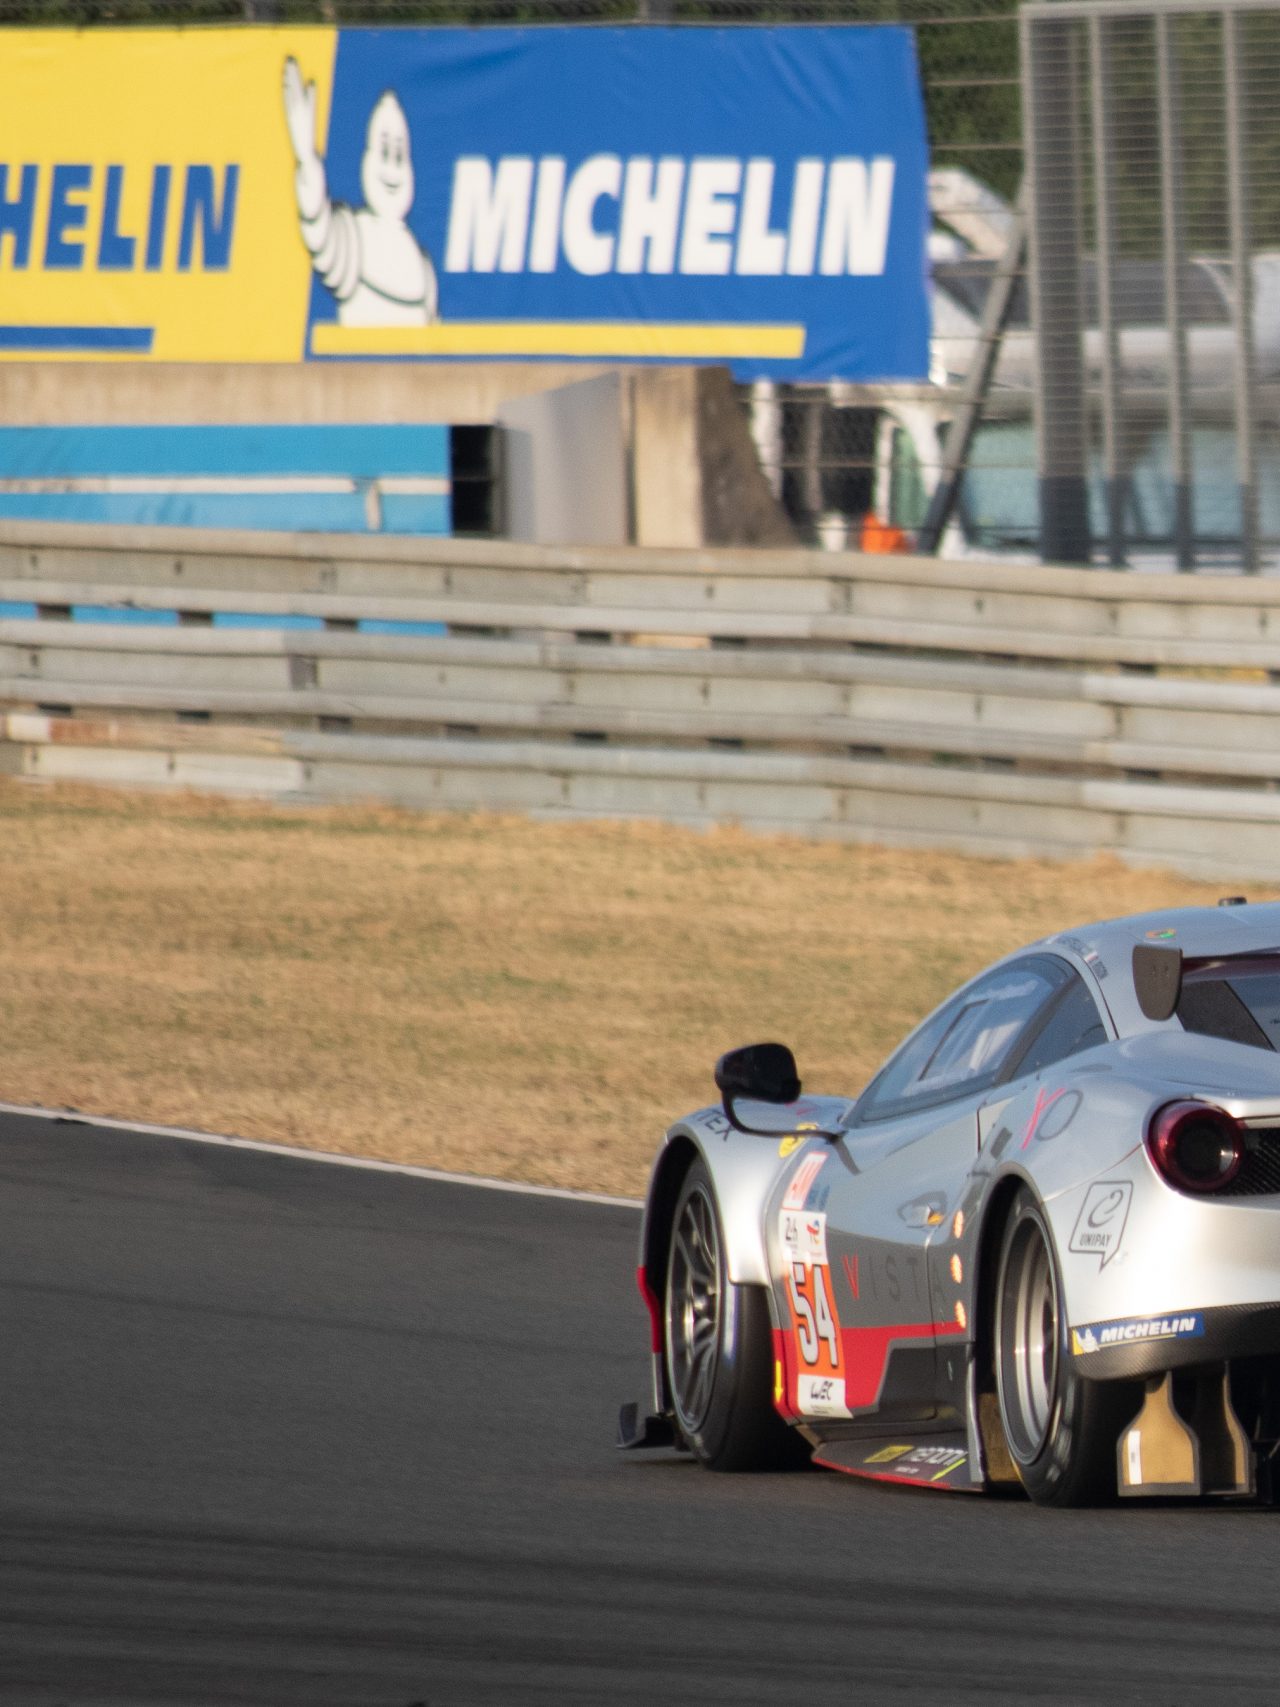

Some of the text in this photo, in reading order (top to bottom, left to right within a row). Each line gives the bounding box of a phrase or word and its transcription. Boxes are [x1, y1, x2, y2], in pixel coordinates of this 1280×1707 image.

[0, 163, 240, 271] HELIN
[445, 154, 895, 276] MICHELIN
[1079, 1233, 1113, 1248] UNIPAY
[789, 1261, 840, 1368] 54
[1100, 1317, 1197, 1343] MICHELIN
